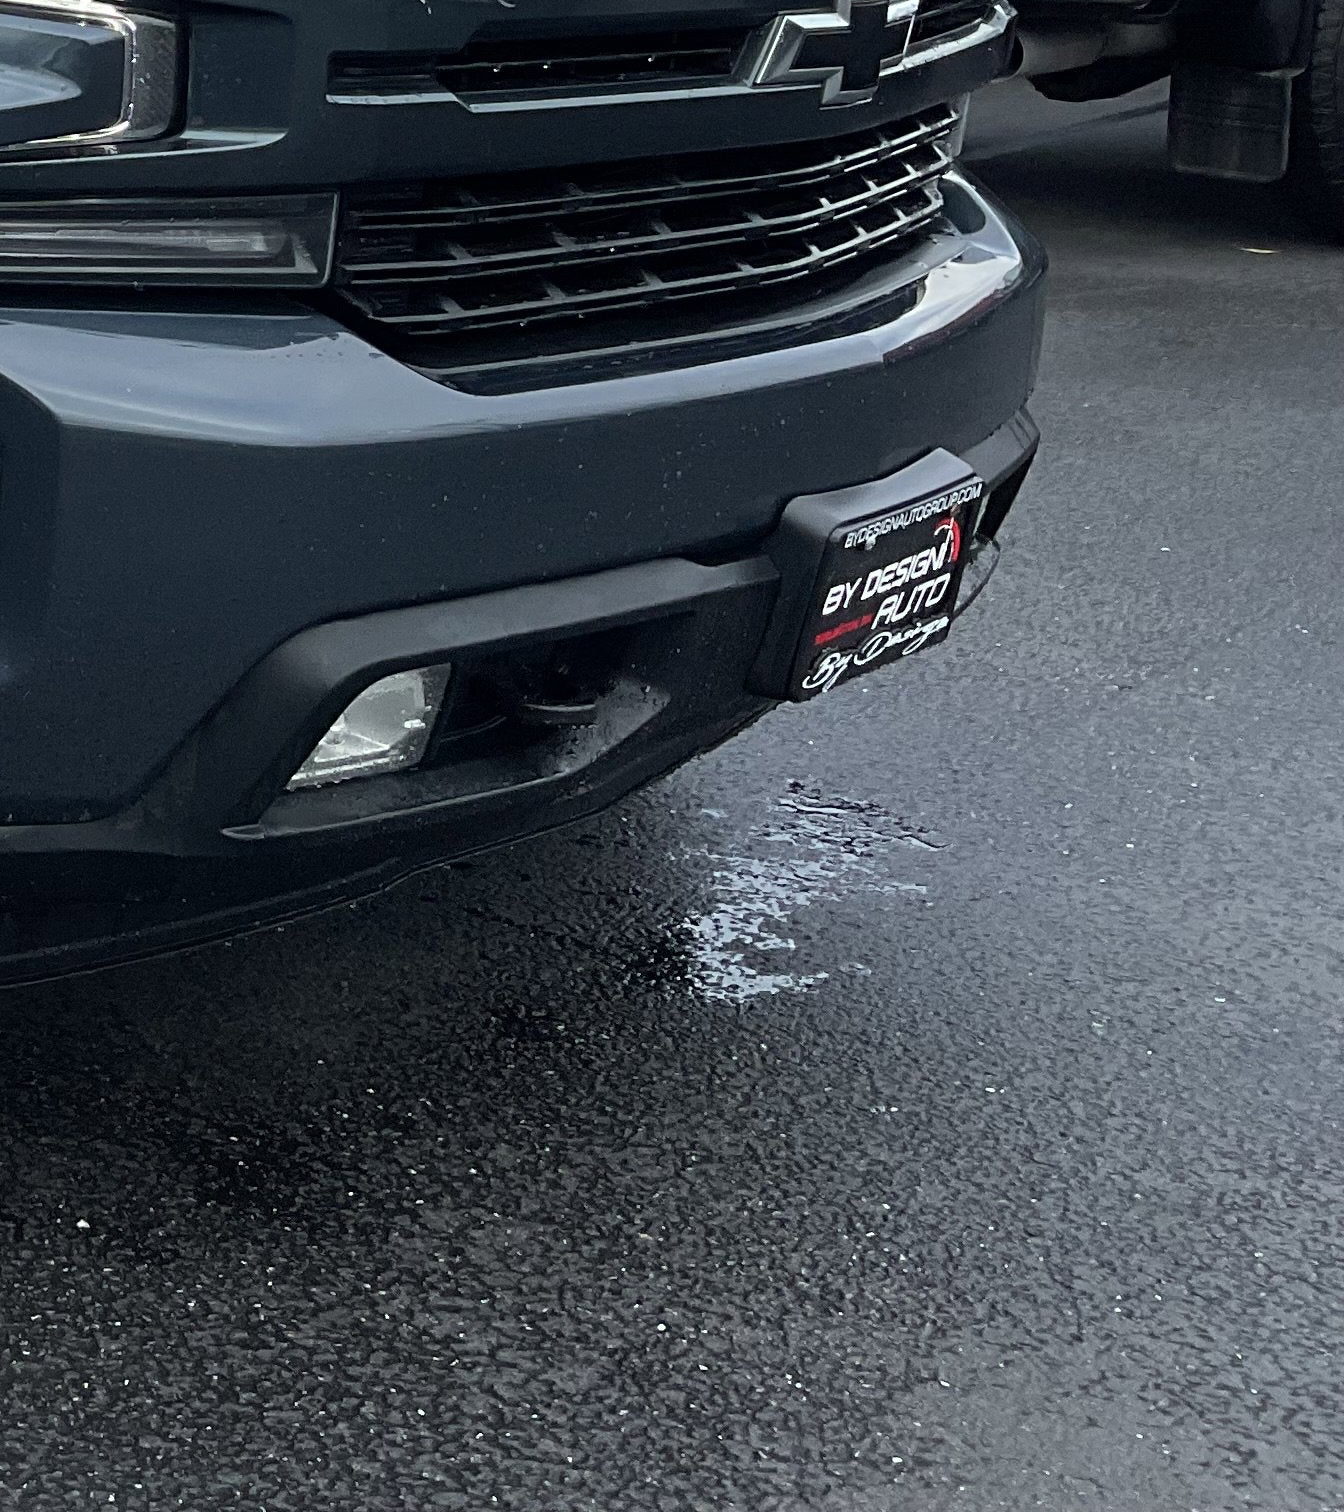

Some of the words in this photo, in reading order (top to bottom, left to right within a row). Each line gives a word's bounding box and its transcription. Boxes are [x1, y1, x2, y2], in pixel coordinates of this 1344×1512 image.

[844, 483, 983, 549] BYDESIGNAUTOGROUP.COM
[822, 577, 862, 616] BY
[861, 544, 949, 601] DESIGN
[870, 573, 951, 630] AUTO
[802, 652, 852, 693] By
[853, 616, 950, 666] Design
